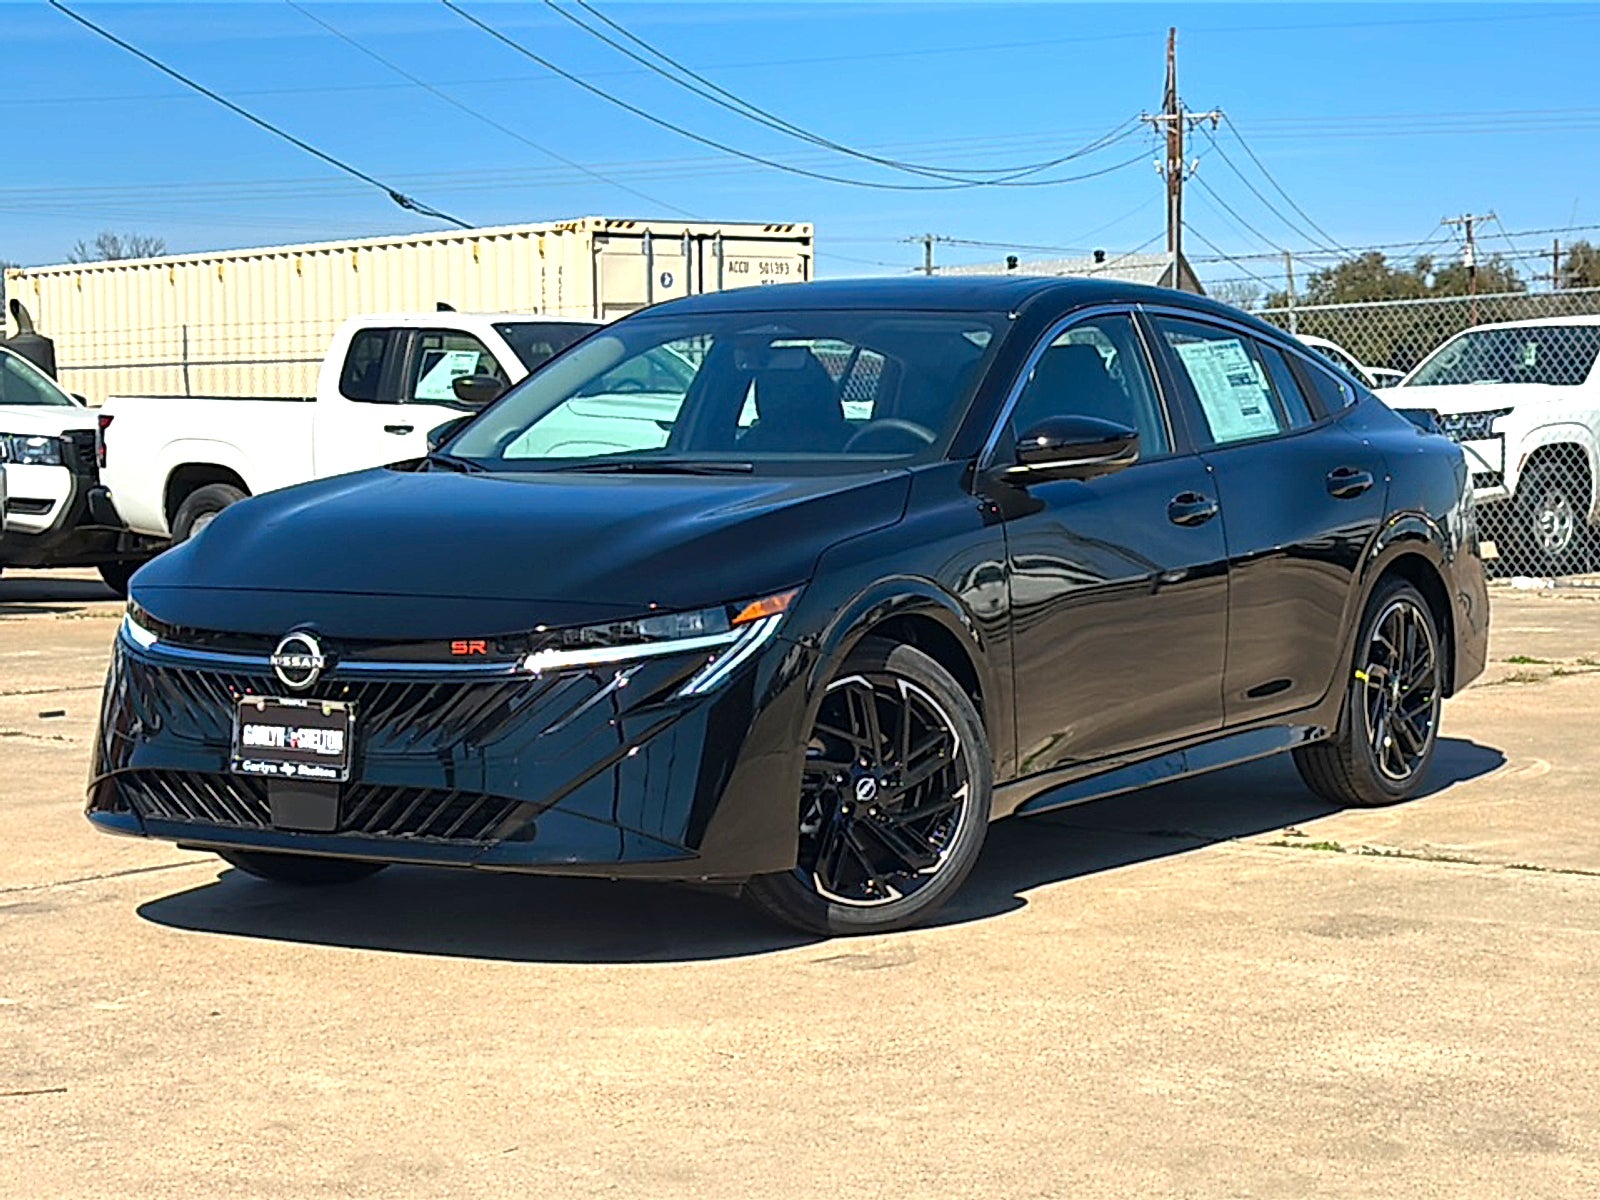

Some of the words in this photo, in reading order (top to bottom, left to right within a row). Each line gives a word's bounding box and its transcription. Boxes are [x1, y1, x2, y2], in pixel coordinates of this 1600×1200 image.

[728, 260, 750, 274] ACCU
[759, 261, 790, 275] 501393
[451, 640, 487, 655] SR
[270, 655, 325, 668] NISSAN
